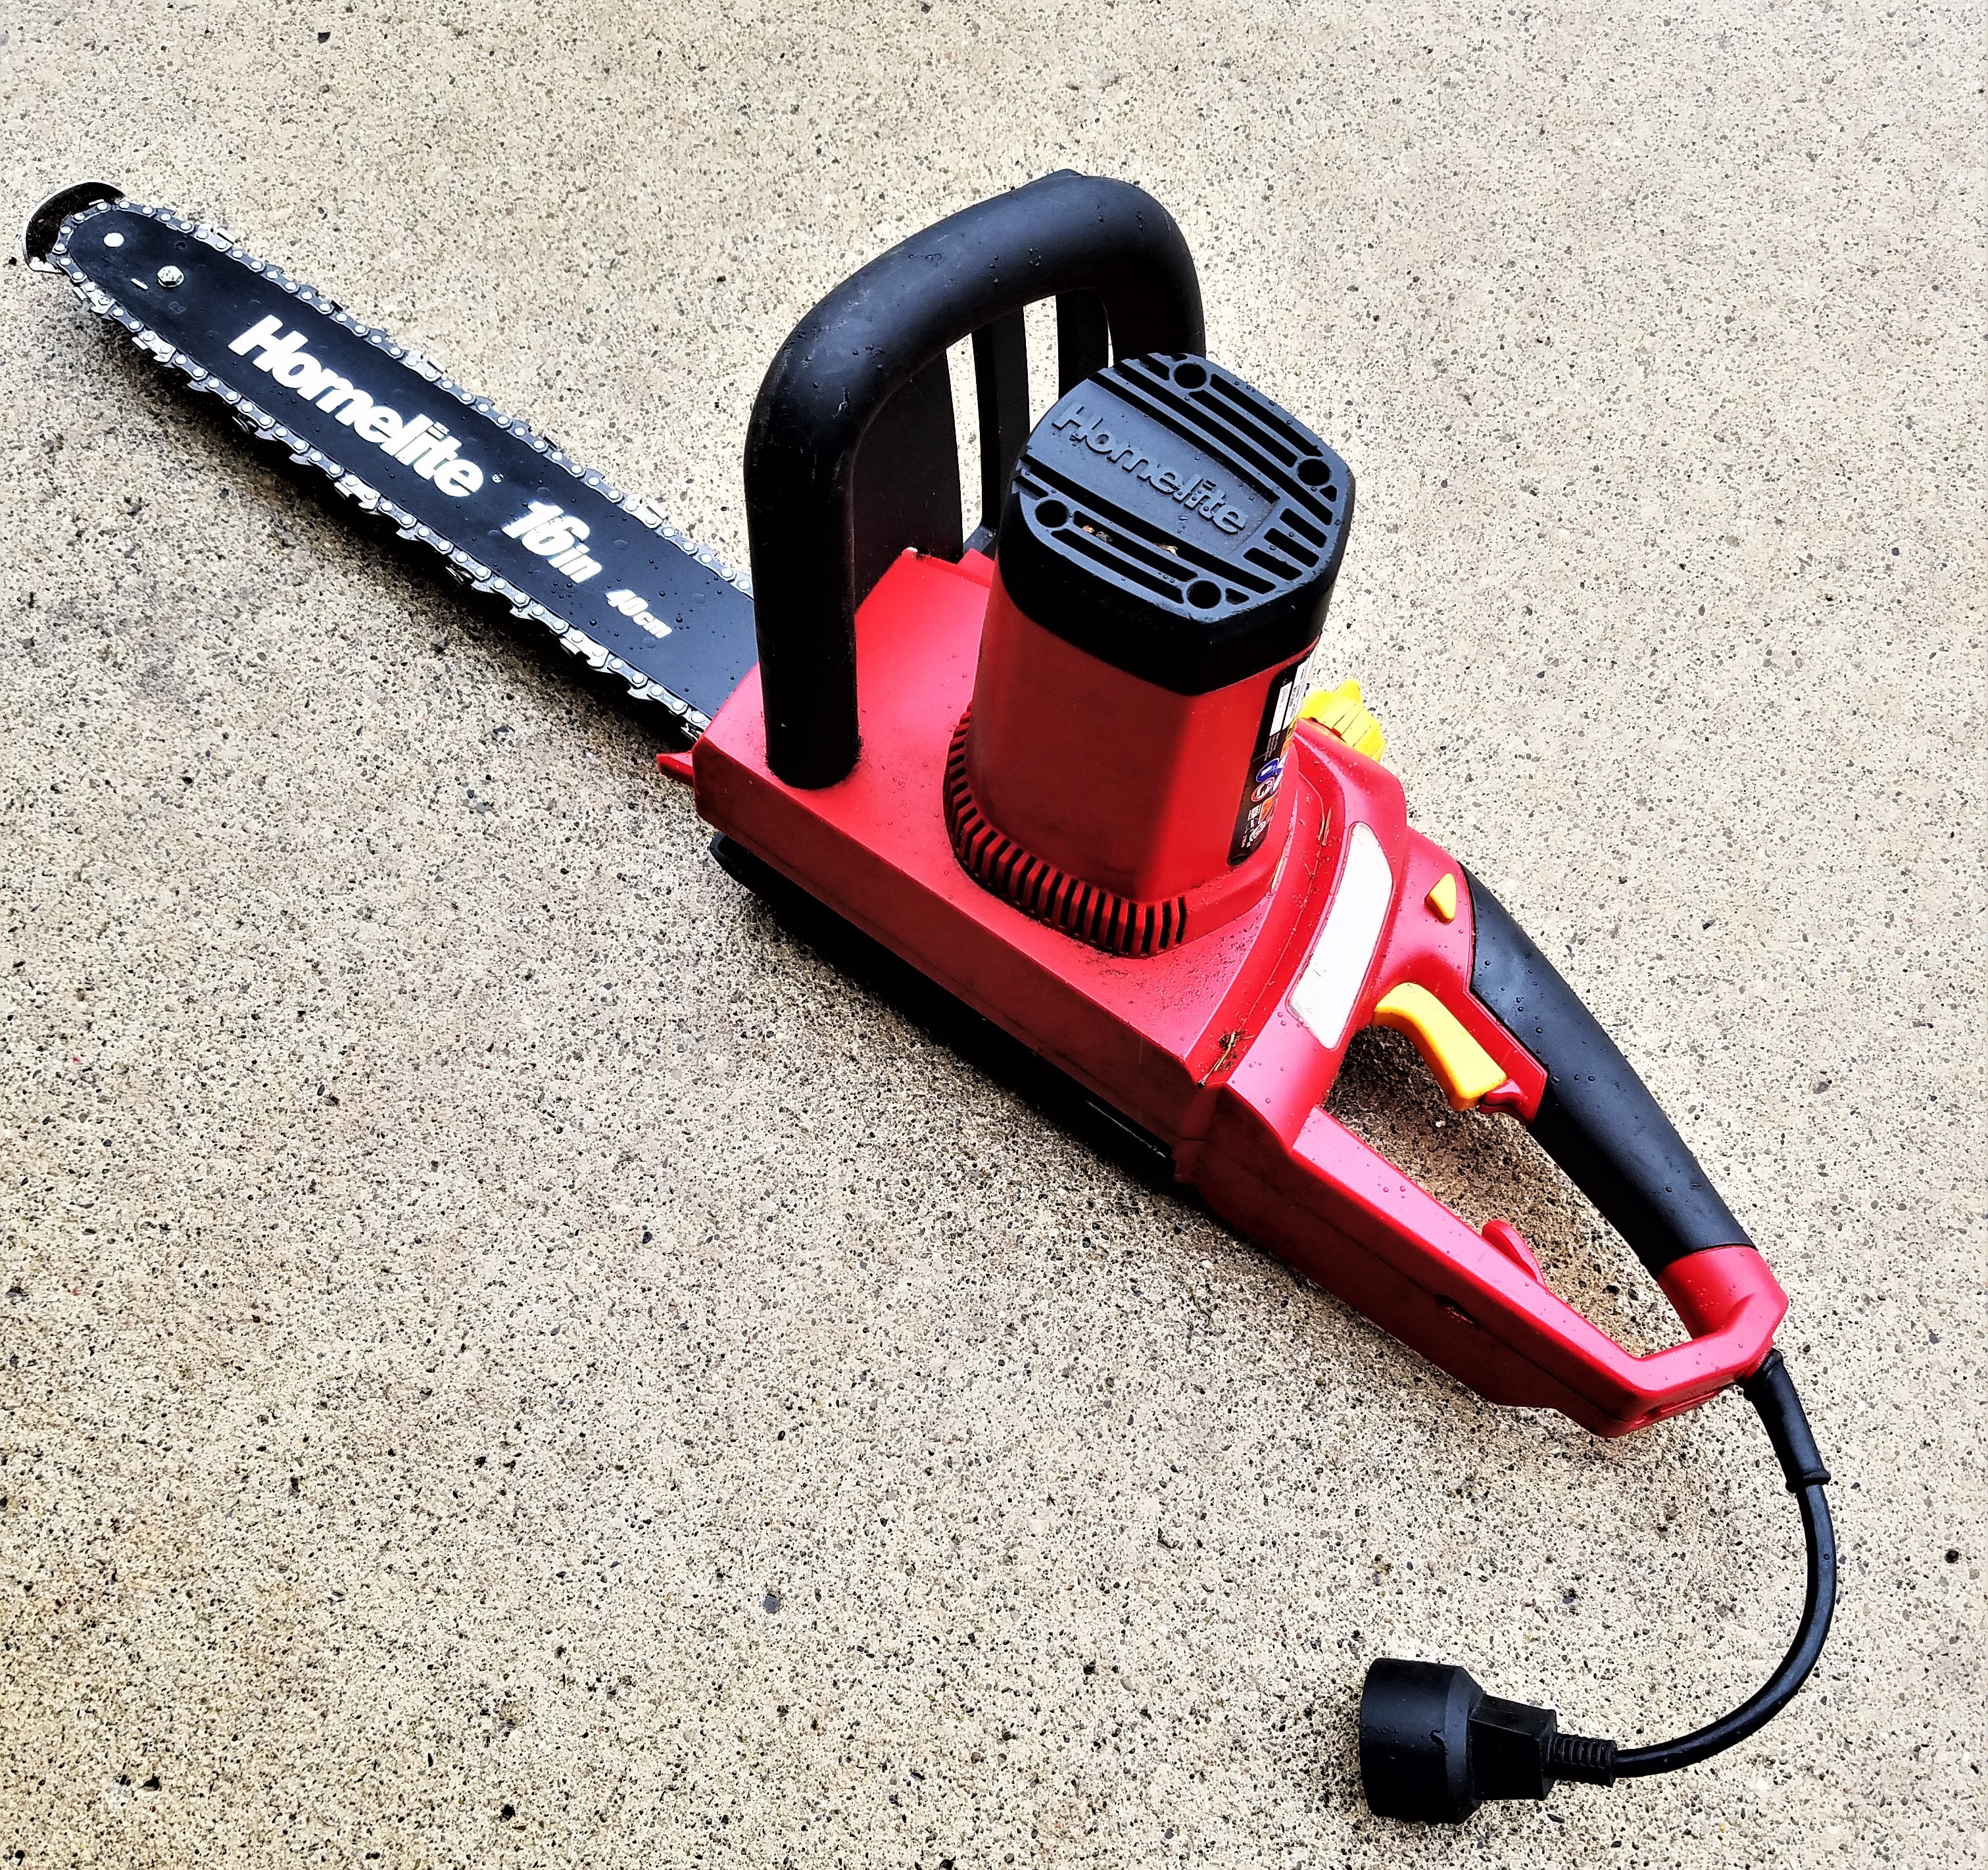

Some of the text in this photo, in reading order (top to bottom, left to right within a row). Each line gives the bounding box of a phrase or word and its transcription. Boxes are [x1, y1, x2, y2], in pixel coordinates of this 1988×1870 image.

[228, 314, 484, 497] Homelite
[605, 589, 673, 639] 40cm
[1052, 403, 1248, 535] Homelite
